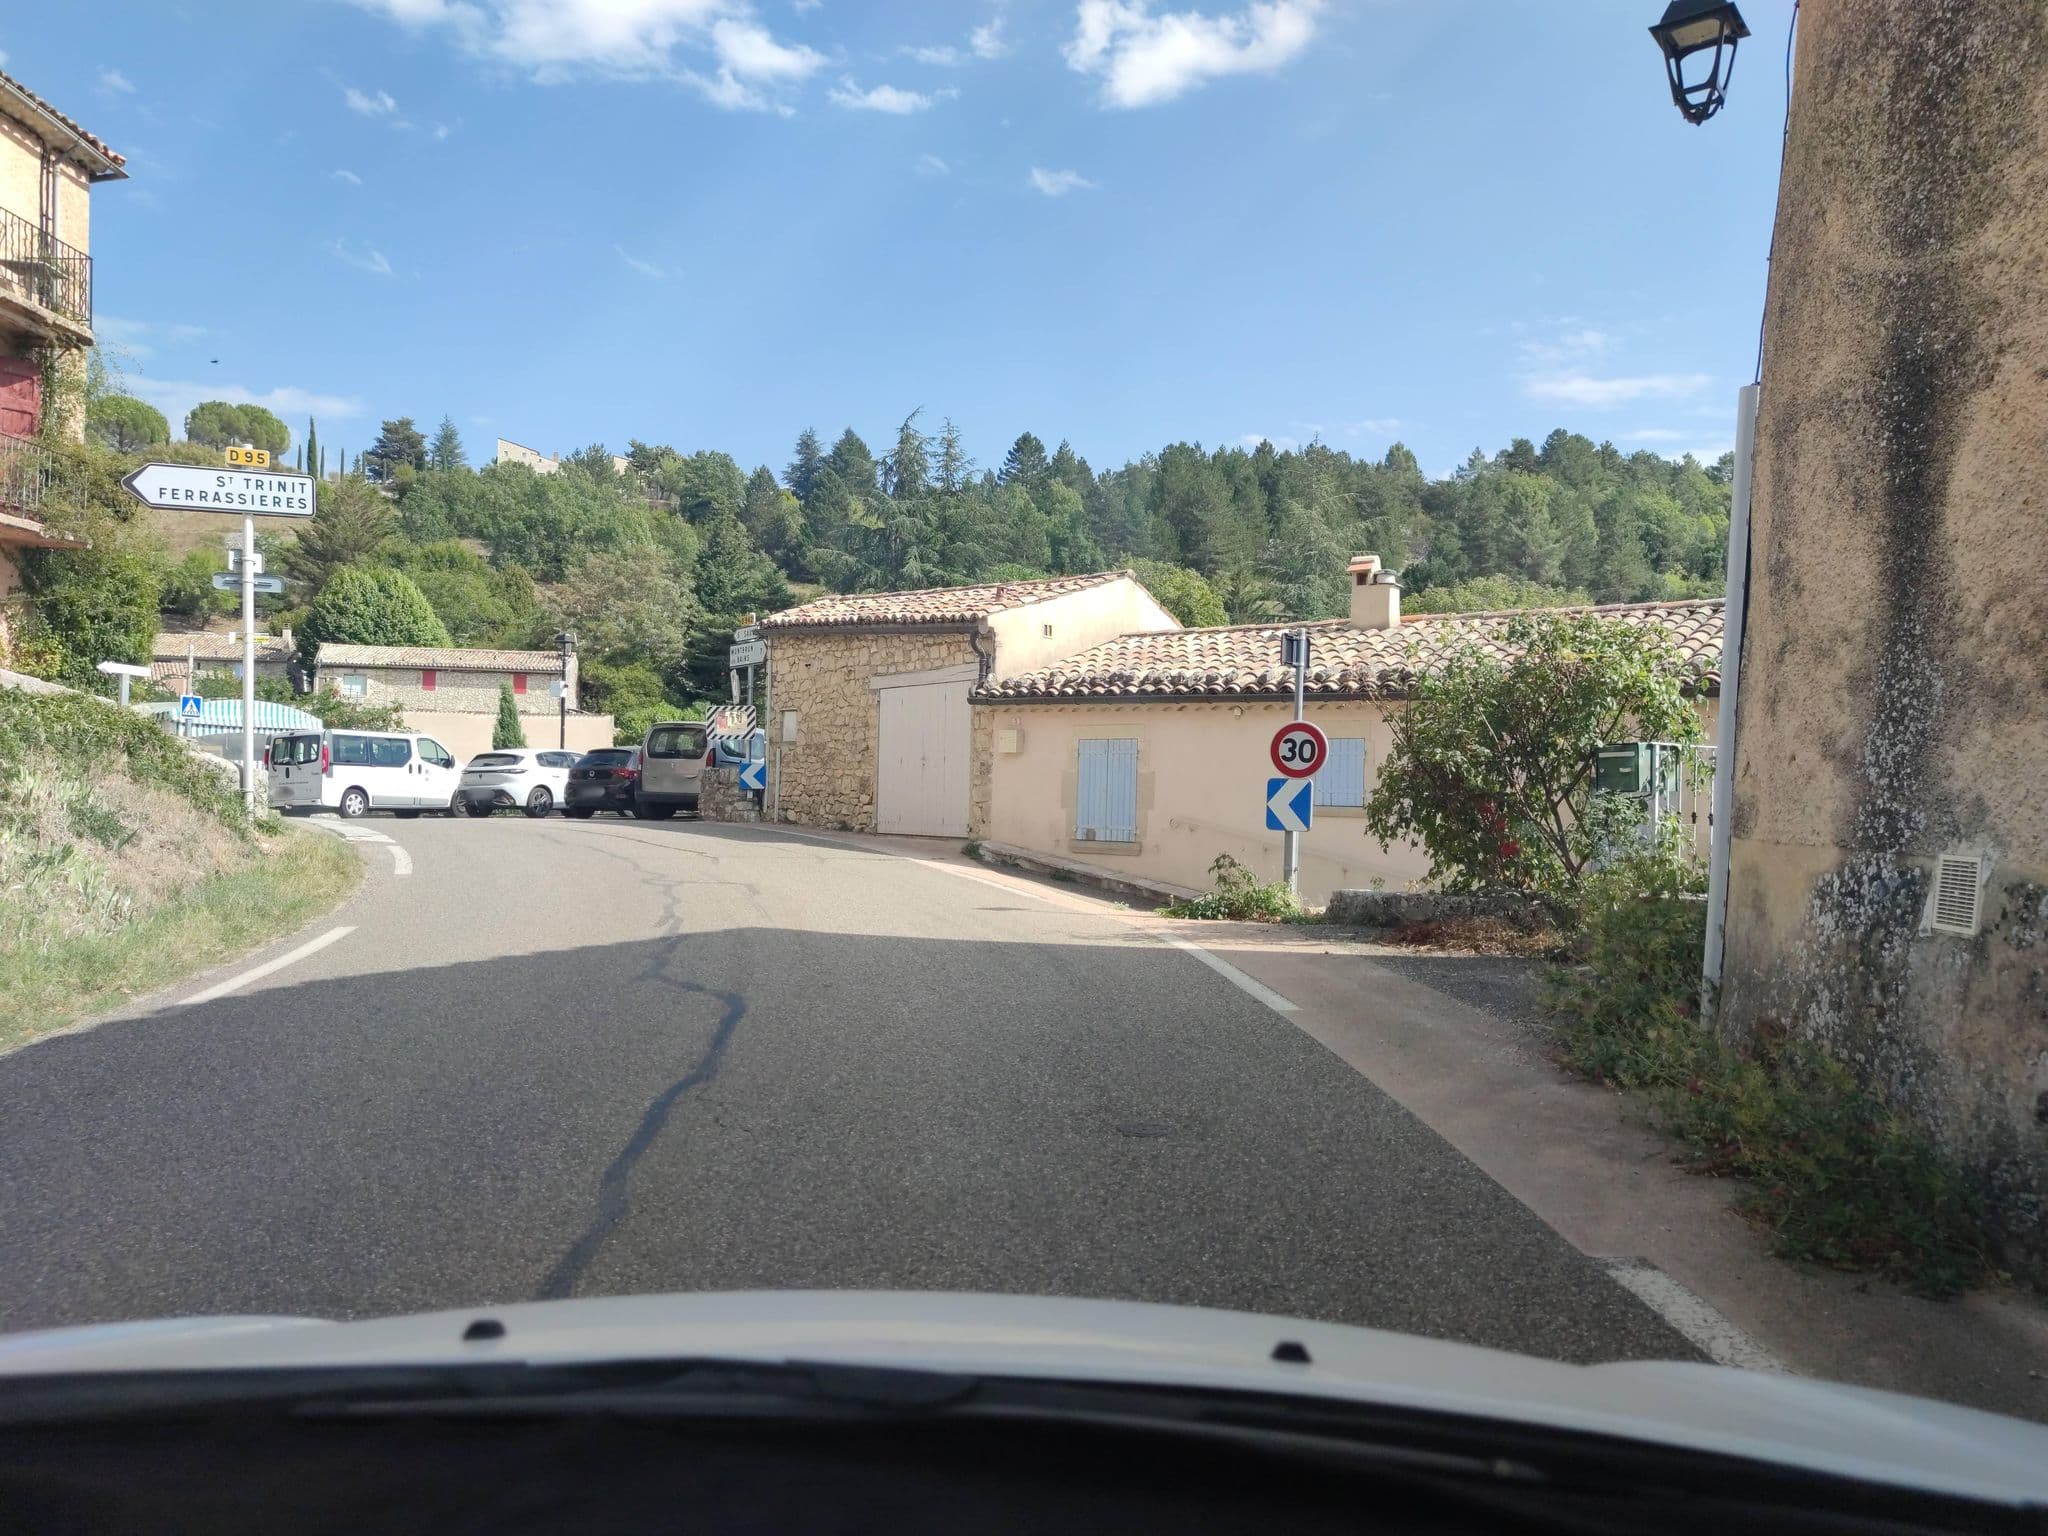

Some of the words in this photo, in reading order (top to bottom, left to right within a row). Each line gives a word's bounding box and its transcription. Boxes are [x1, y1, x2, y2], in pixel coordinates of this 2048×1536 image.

[229, 450, 239, 461] D
[244, 451, 265, 464] 95
[243, 478, 307, 494] TRINIT
[159, 487, 307, 509] FERRASSIERES
[1281, 738, 1316, 763] 30
